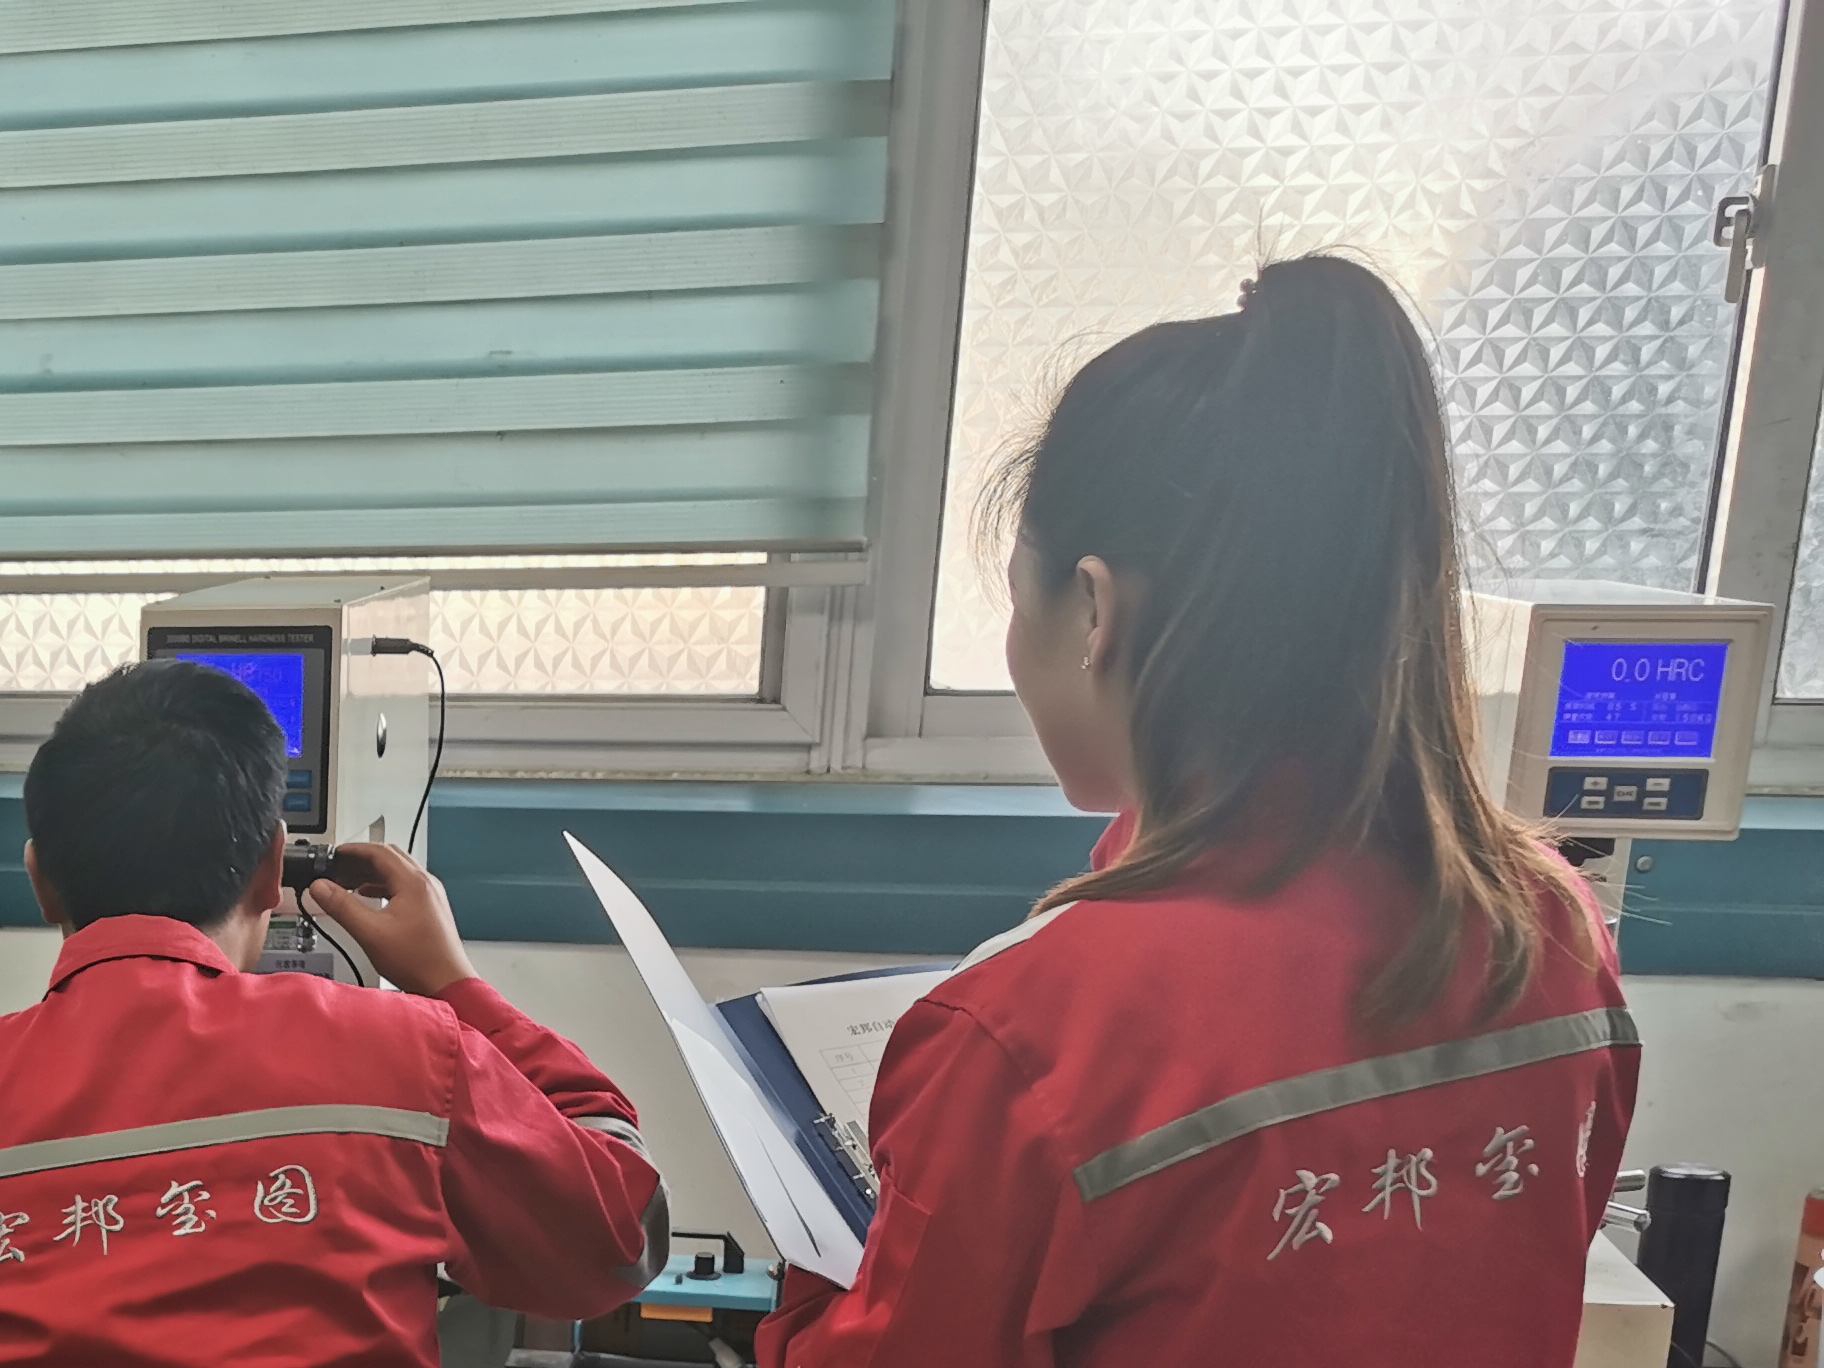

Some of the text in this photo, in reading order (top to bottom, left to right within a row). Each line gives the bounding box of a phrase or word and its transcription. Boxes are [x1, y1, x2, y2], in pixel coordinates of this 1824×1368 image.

[1611, 657, 1705, 682] 0.0 HRC
[1266, 1101, 1597, 1261] 宏邦玺
